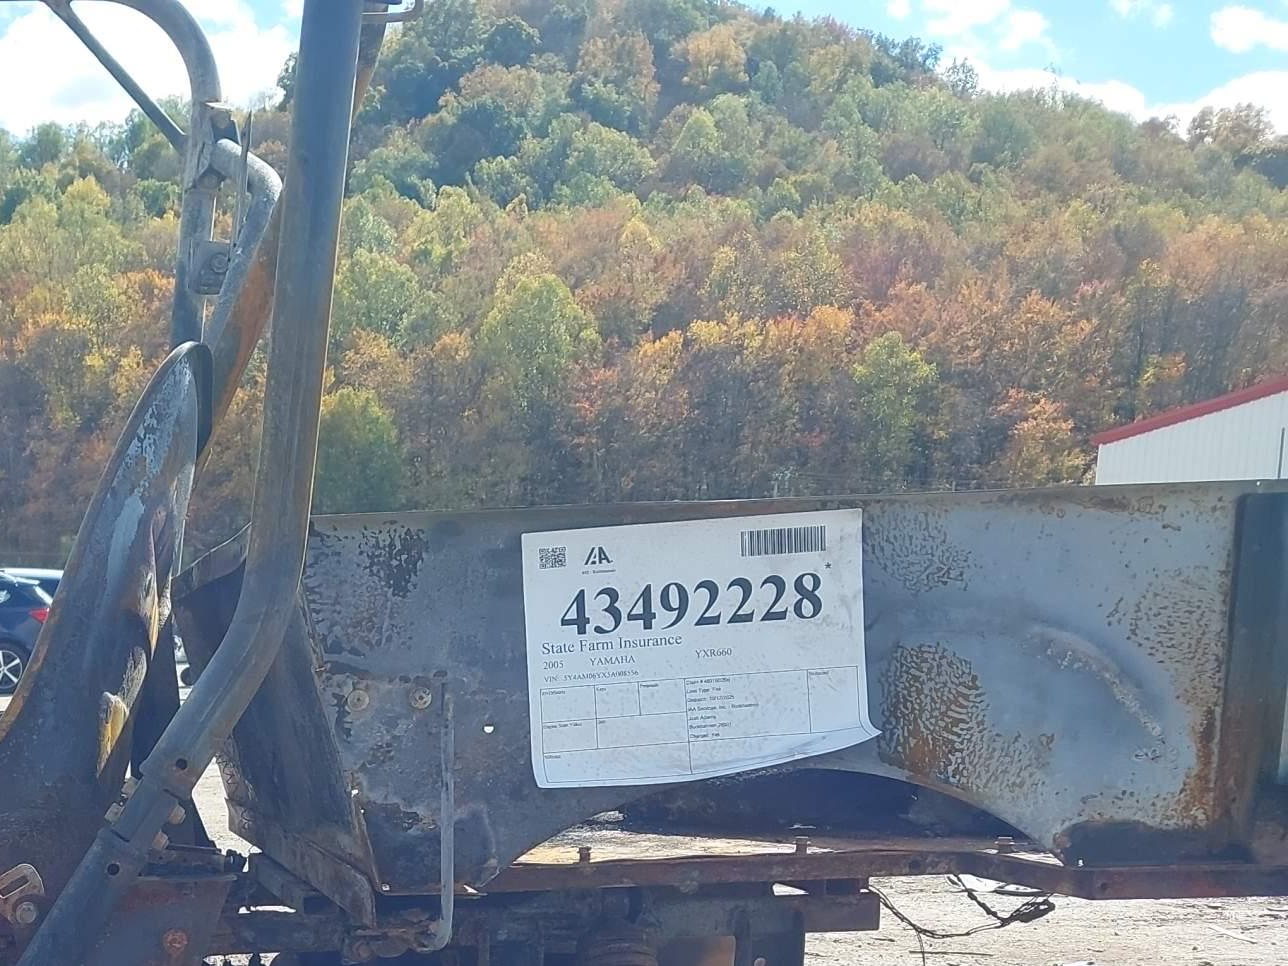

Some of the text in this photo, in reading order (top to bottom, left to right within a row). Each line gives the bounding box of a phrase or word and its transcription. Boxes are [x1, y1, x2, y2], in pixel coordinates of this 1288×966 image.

[560, 572, 822, 635] 43492228
[542, 635, 682, 655] State Farm Insurance
[543, 648, 732, 670] 2005 YAMAHA YXR660
